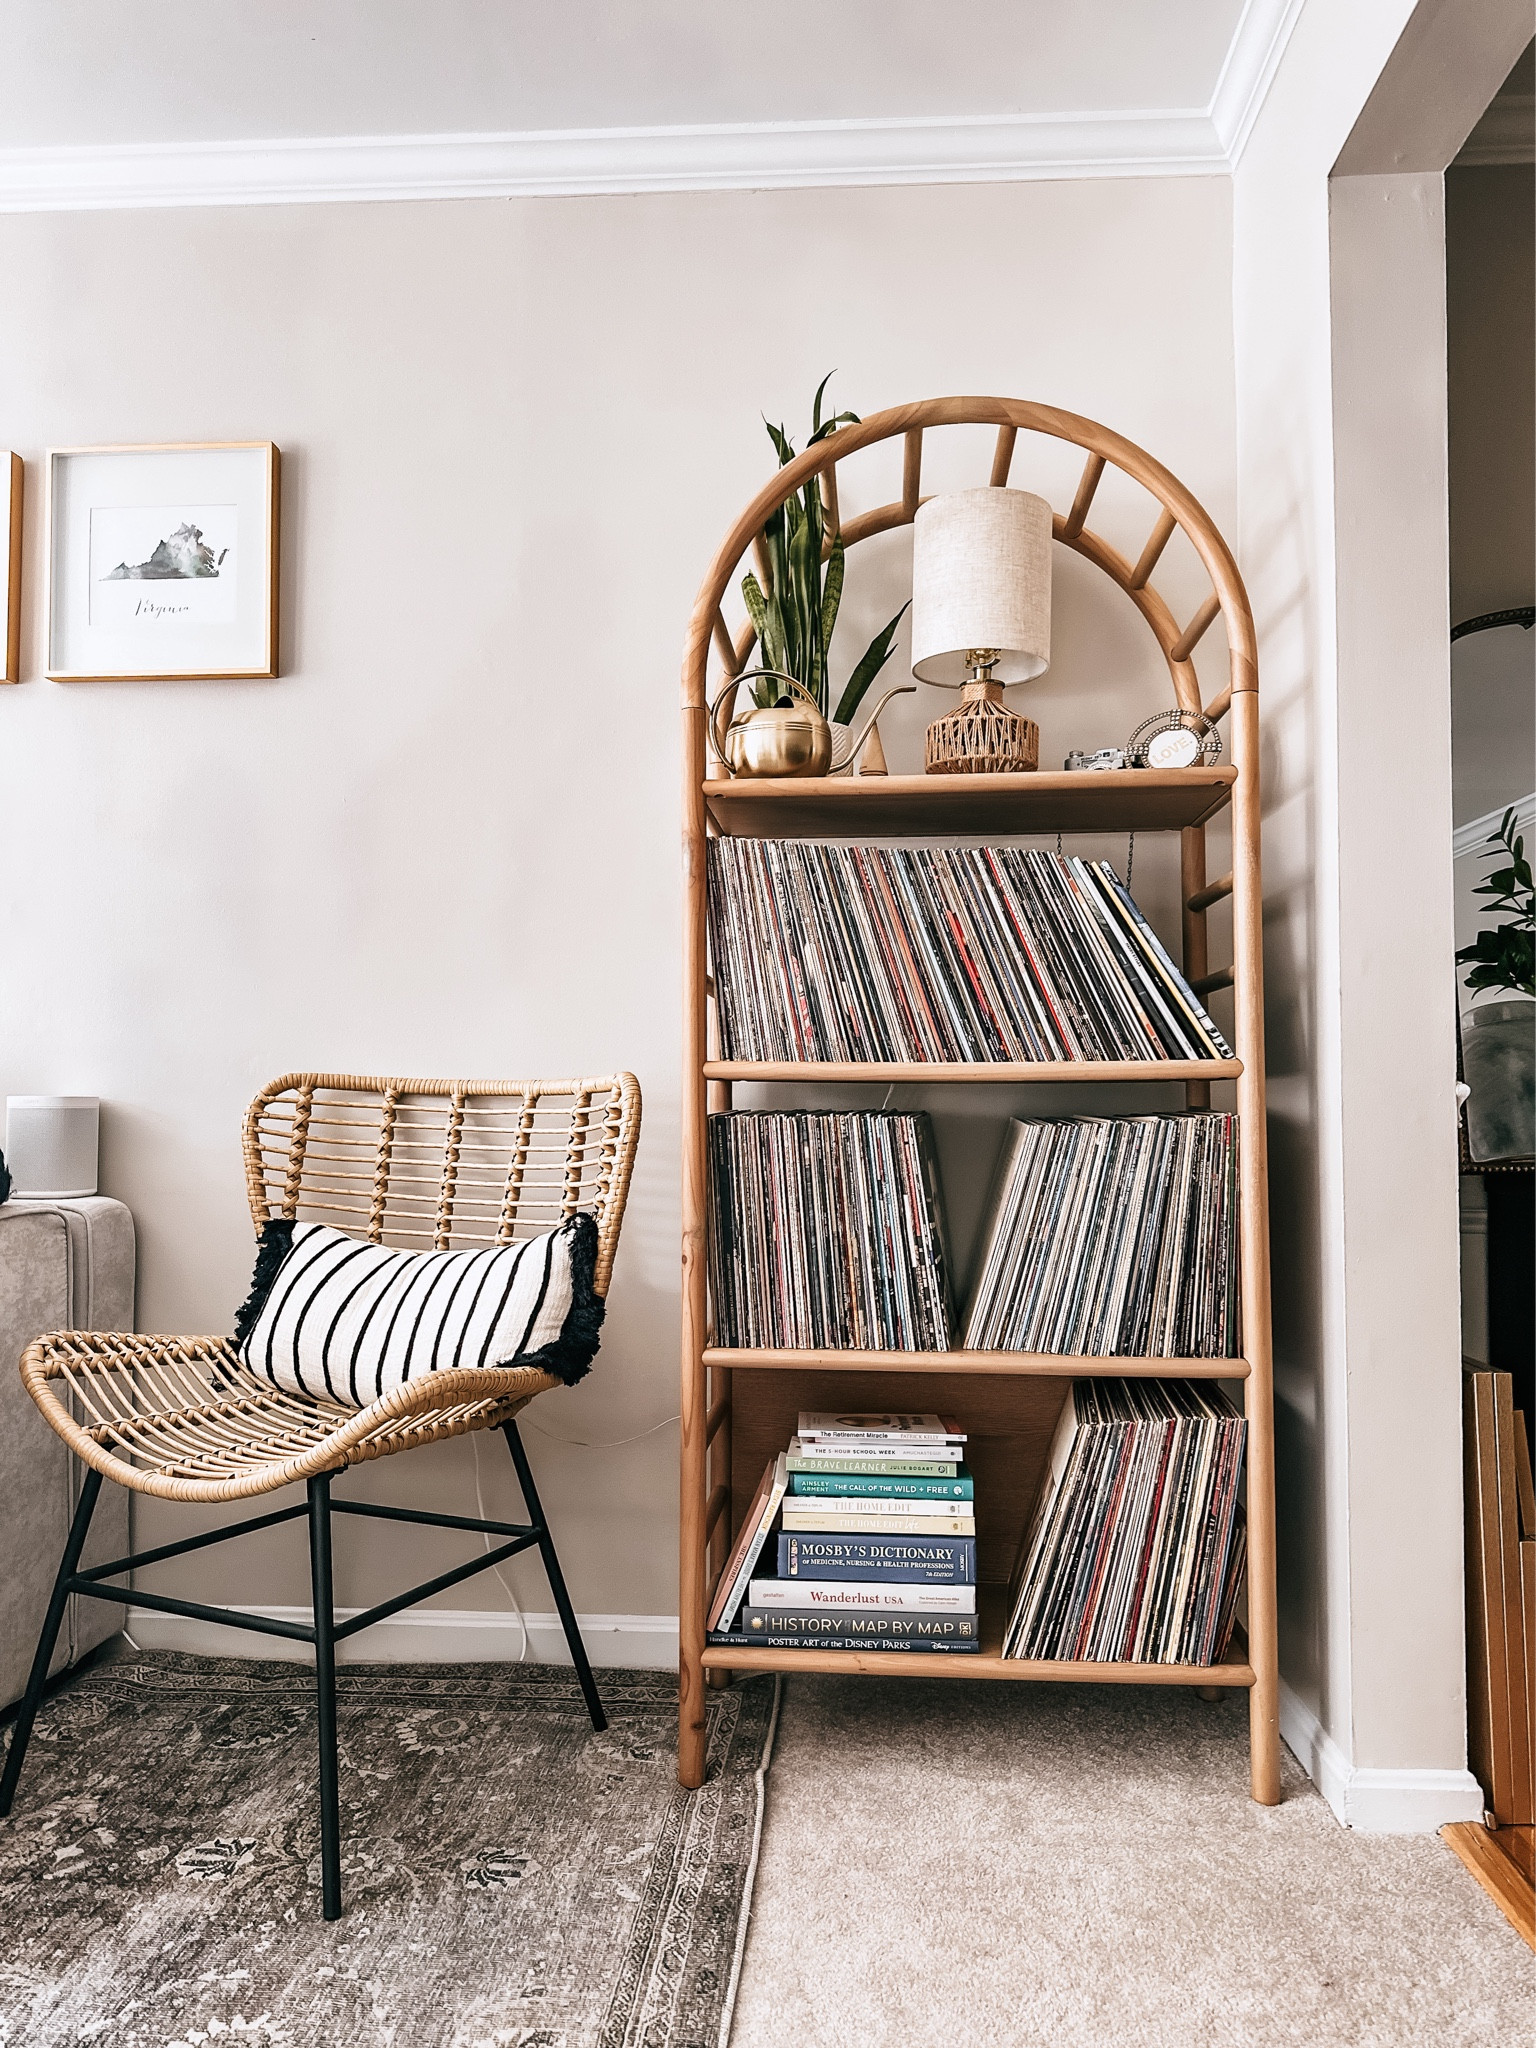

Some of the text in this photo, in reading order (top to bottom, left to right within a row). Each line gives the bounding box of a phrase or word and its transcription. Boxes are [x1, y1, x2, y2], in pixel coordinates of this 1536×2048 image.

[135, 598, 189, 619] Virginia
[794, 1459, 887, 1472] The BRAVE LEARNER
[834, 1502, 912, 1512] THE HOME EDIT
[858, 1519, 881, 1528] HOME
[883, 1520, 902, 1529] EDIT
[802, 1544, 954, 1560] MOSBY'S DICTIONARY
[810, 1592, 880, 1604] Wanderlust
[771, 1617, 842, 1631] HISTORY
[852, 1620, 888, 1632] MAP
[892, 1621, 913, 1633] BY
[918, 1622, 954, 1634] MAP
[768, 1638, 799, 1646] POSTER
